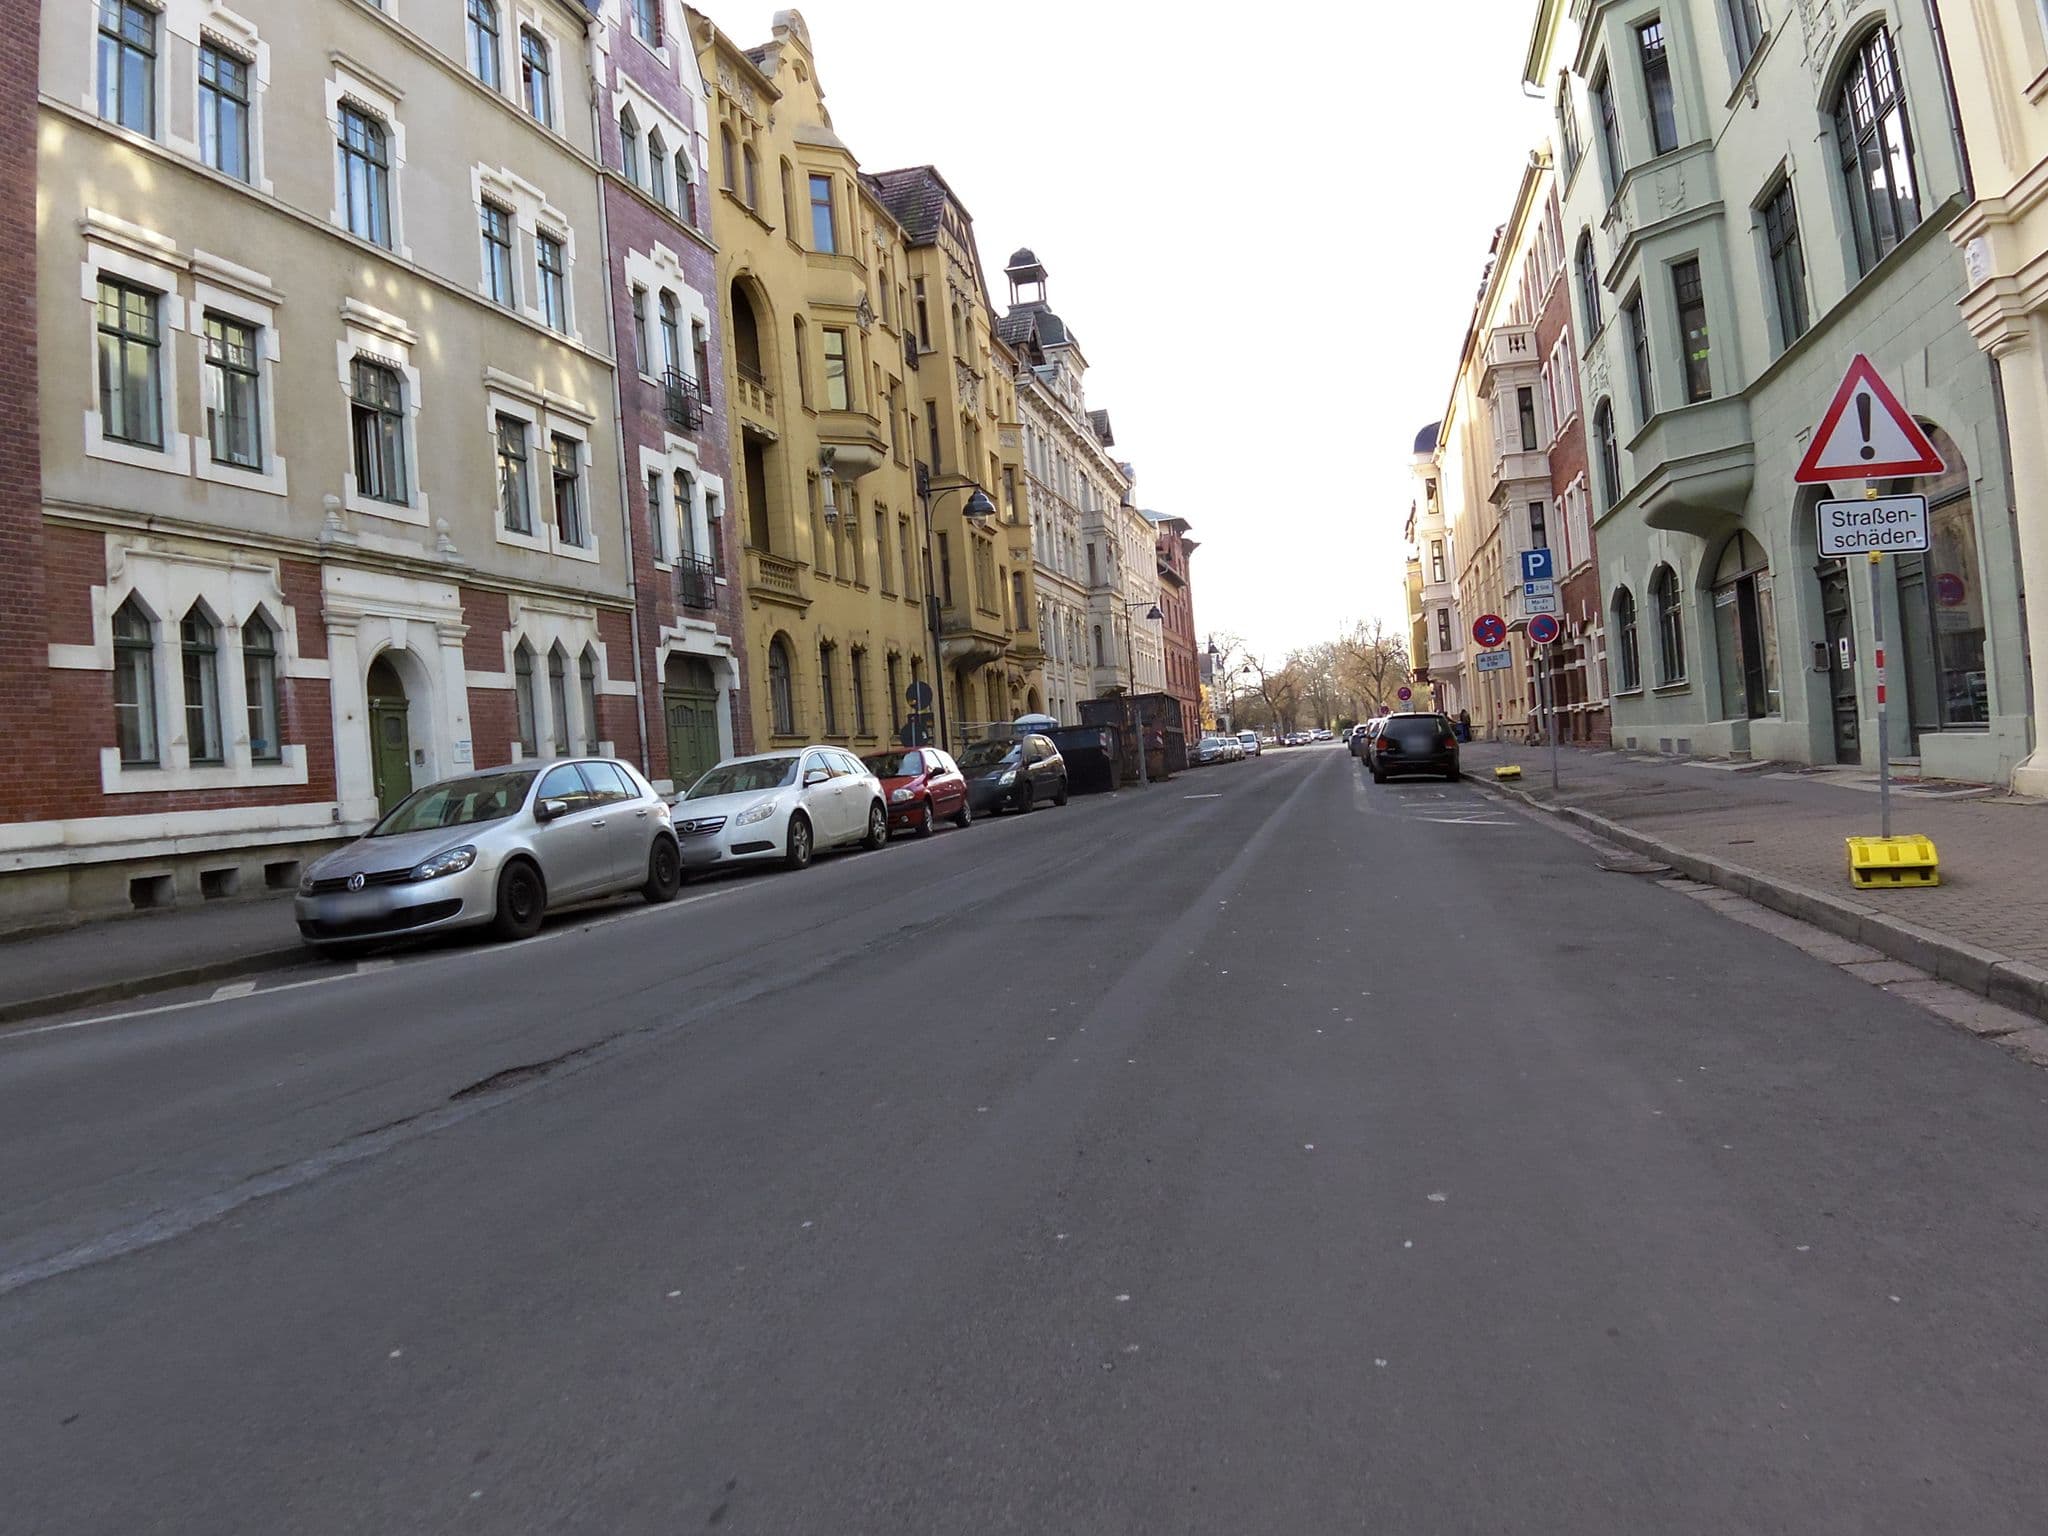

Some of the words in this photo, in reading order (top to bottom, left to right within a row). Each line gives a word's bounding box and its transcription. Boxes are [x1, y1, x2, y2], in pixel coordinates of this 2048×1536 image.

[1831, 507, 1918, 528] Straßen-
[1834, 528, 1918, 548] schäden
[1528, 553, 1545, 577] P
